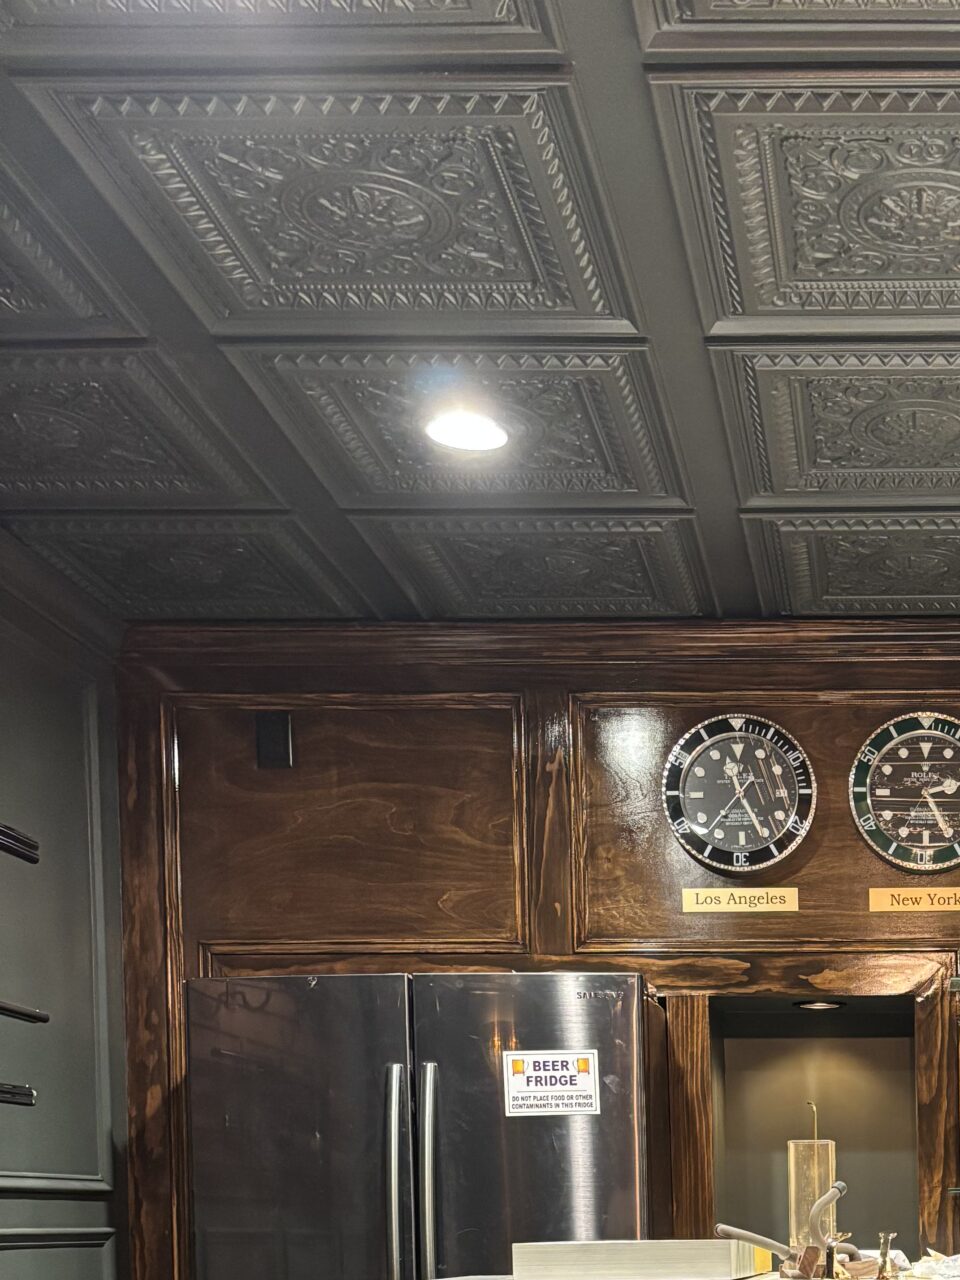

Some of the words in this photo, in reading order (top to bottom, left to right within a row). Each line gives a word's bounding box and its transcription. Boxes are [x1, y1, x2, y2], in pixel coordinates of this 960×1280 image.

[861, 747, 878, 765] 50
[674, 818, 690, 834] 40
[789, 816, 805, 834] 20
[860, 815, 876, 830] 40
[733, 853, 749, 866] 30
[694, 891, 722, 905] Los
[727, 891, 787, 908] Angeles
[889, 893, 922, 906] New
[533, 1060, 570, 1072] BEER
[526, 1075, 578, 1087] FRIDGE
[533, 1094, 549, 1102] PLACE
